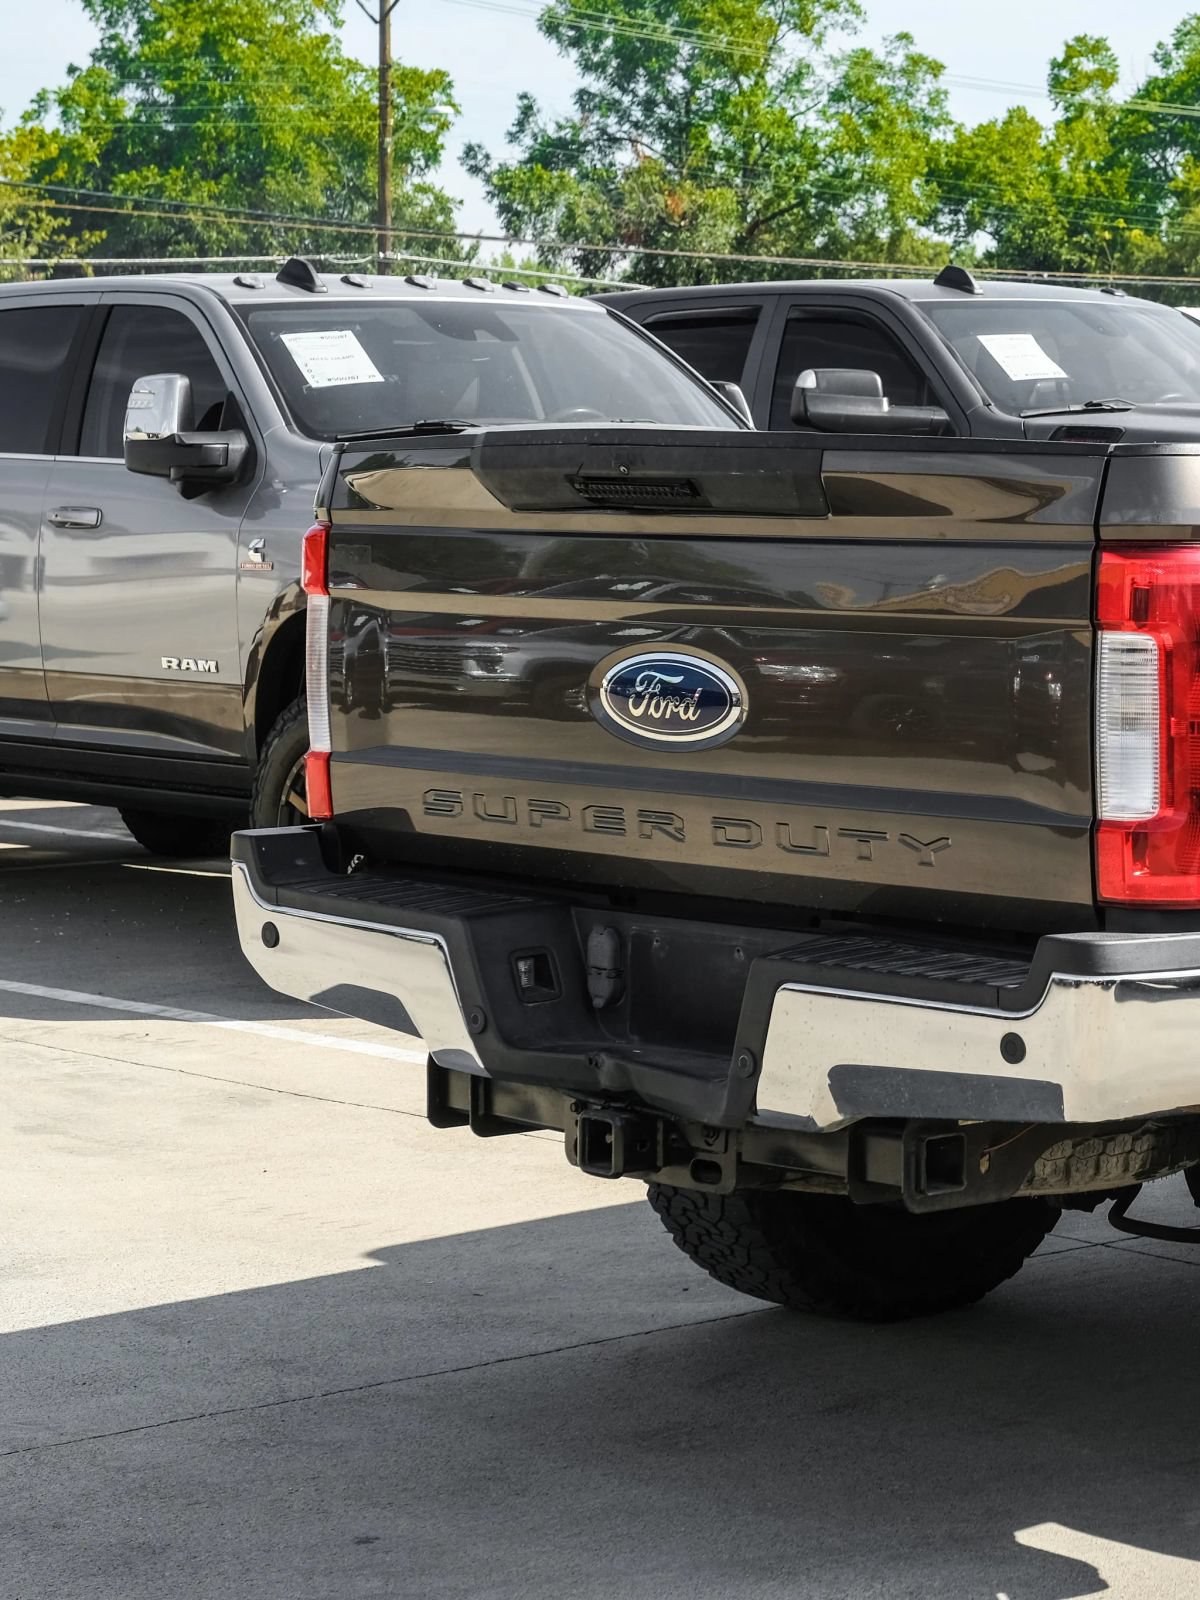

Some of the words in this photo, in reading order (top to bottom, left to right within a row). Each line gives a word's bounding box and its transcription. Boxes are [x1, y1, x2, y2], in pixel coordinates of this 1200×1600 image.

[161, 656, 219, 673] RAM
[628, 671, 703, 721] Ford
[422, 788, 686, 843] SUPER
[711, 815, 953, 868] DUTY
